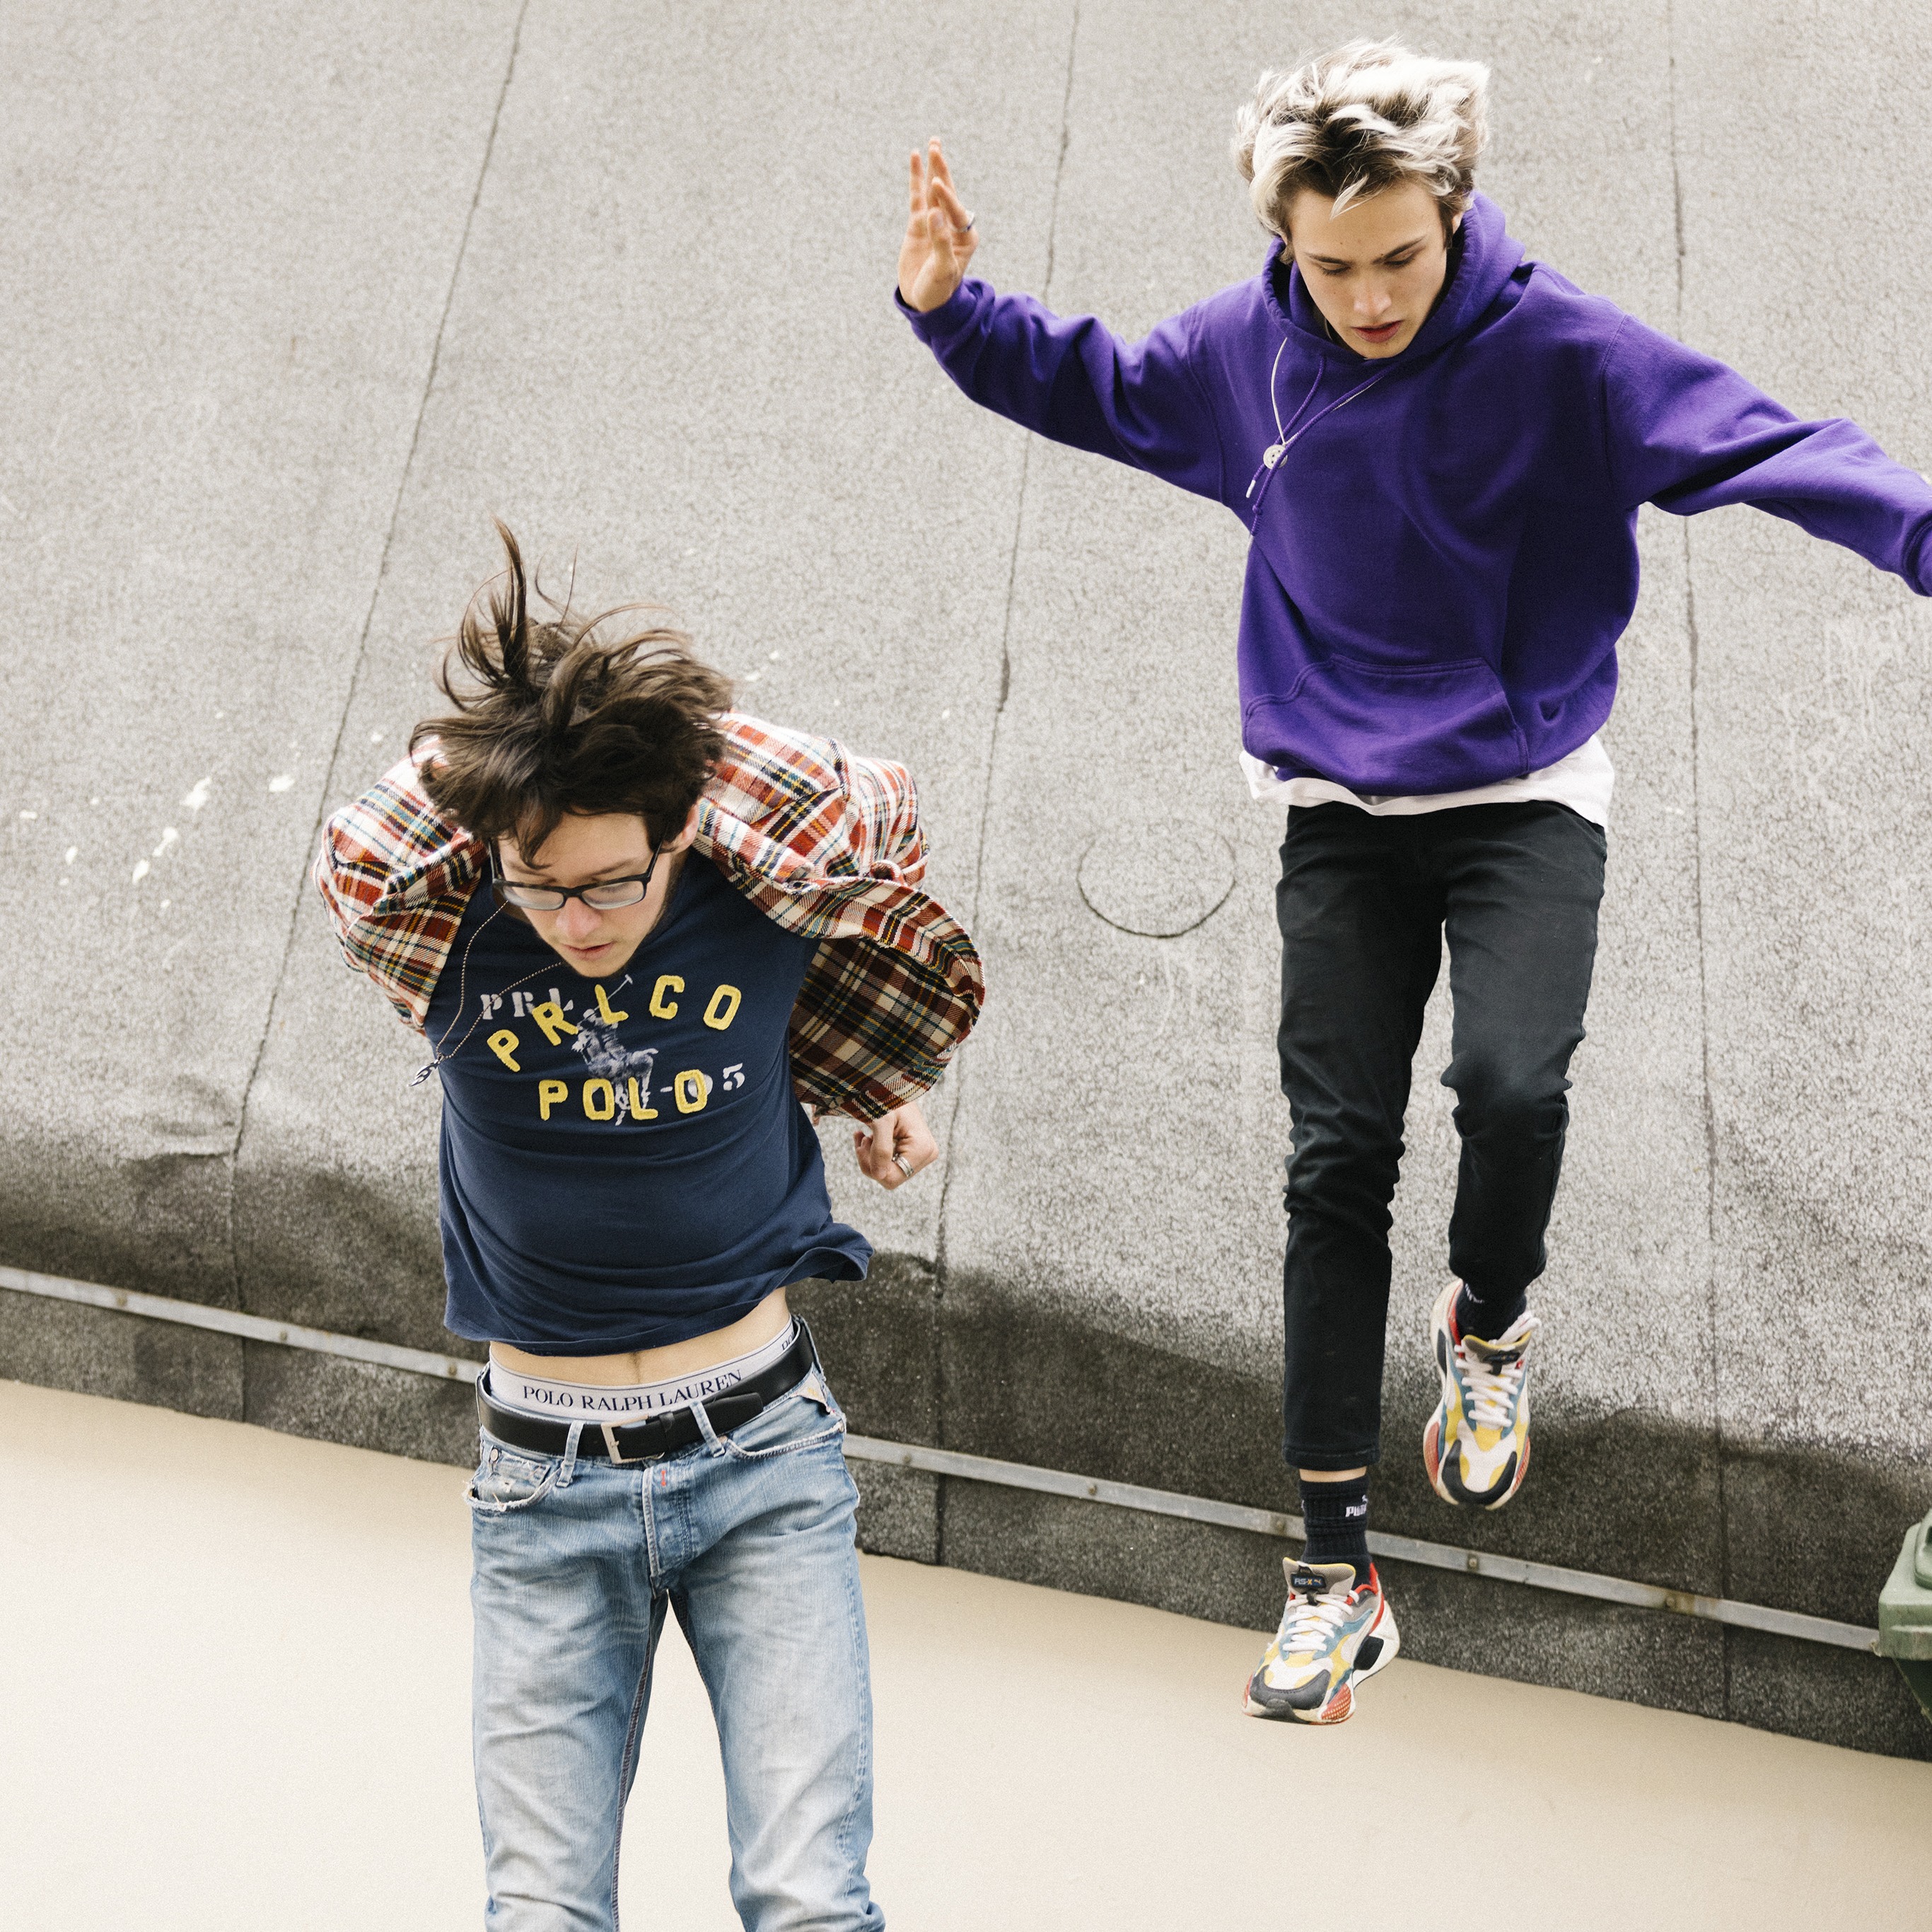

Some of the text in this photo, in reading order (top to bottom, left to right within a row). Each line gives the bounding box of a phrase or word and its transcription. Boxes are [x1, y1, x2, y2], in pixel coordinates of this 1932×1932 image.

[538, 1069, 708, 1121] POLO
[523, 1369, 742, 1412] POLO RALPH LAUREN
